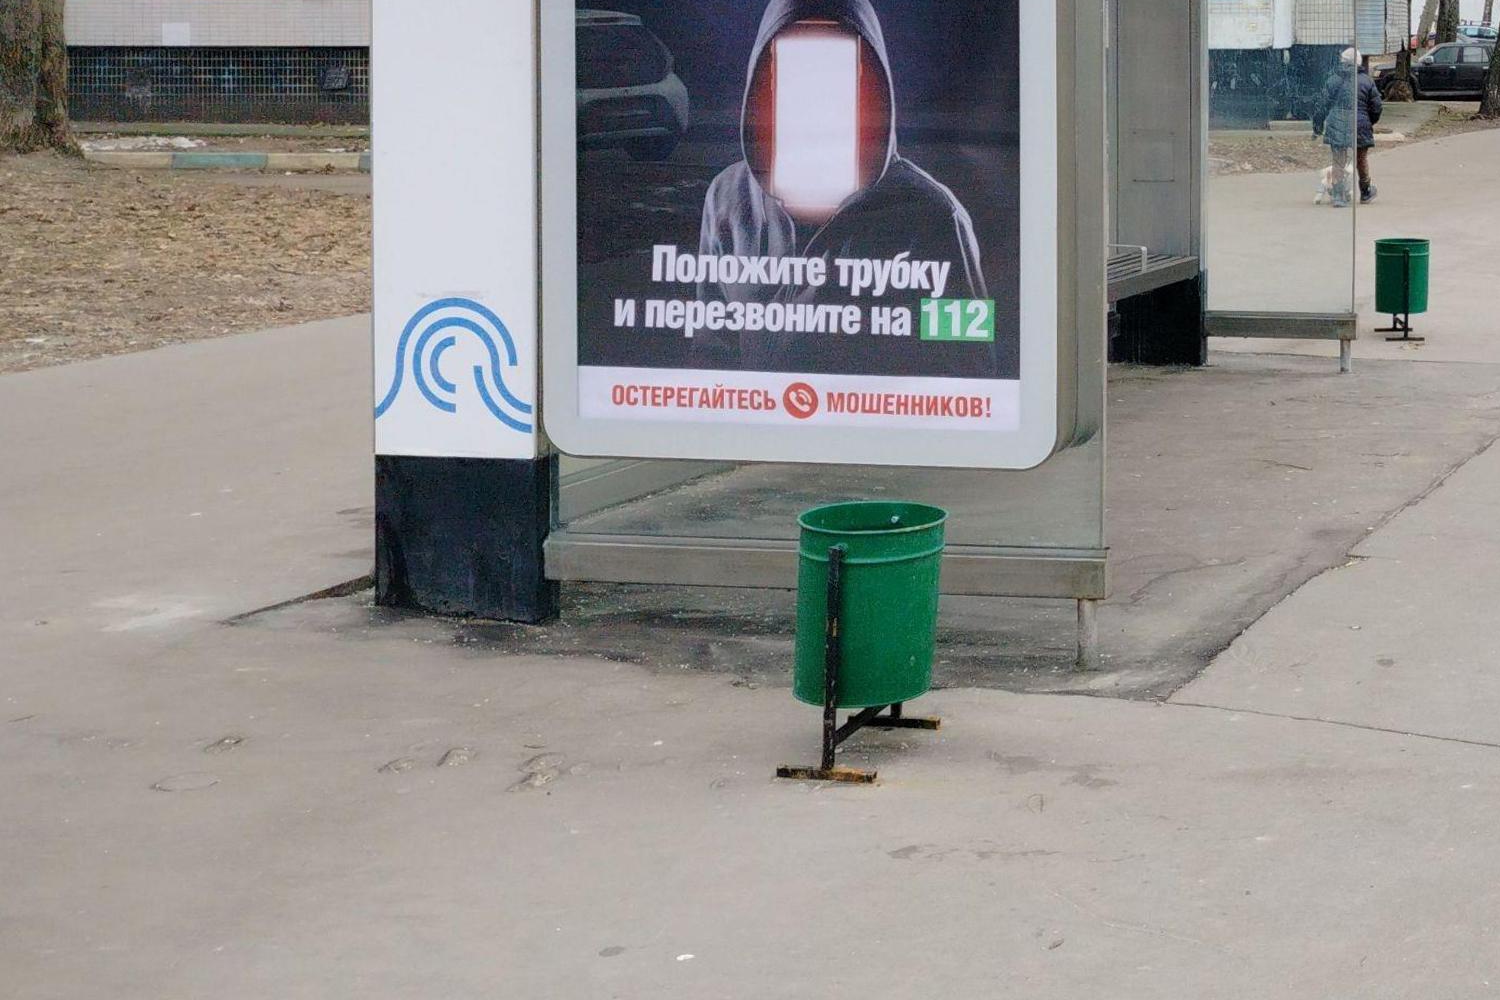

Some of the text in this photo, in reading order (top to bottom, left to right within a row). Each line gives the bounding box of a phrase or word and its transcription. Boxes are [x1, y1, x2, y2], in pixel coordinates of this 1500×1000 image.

[651, 244, 951, 297] Положите трубку
[614, 298, 989, 338] и перезвоните на 112
[611, 383, 992, 418] ОСТЕРЕГАЙТЕСЬ МОШЕННИКОВ!
